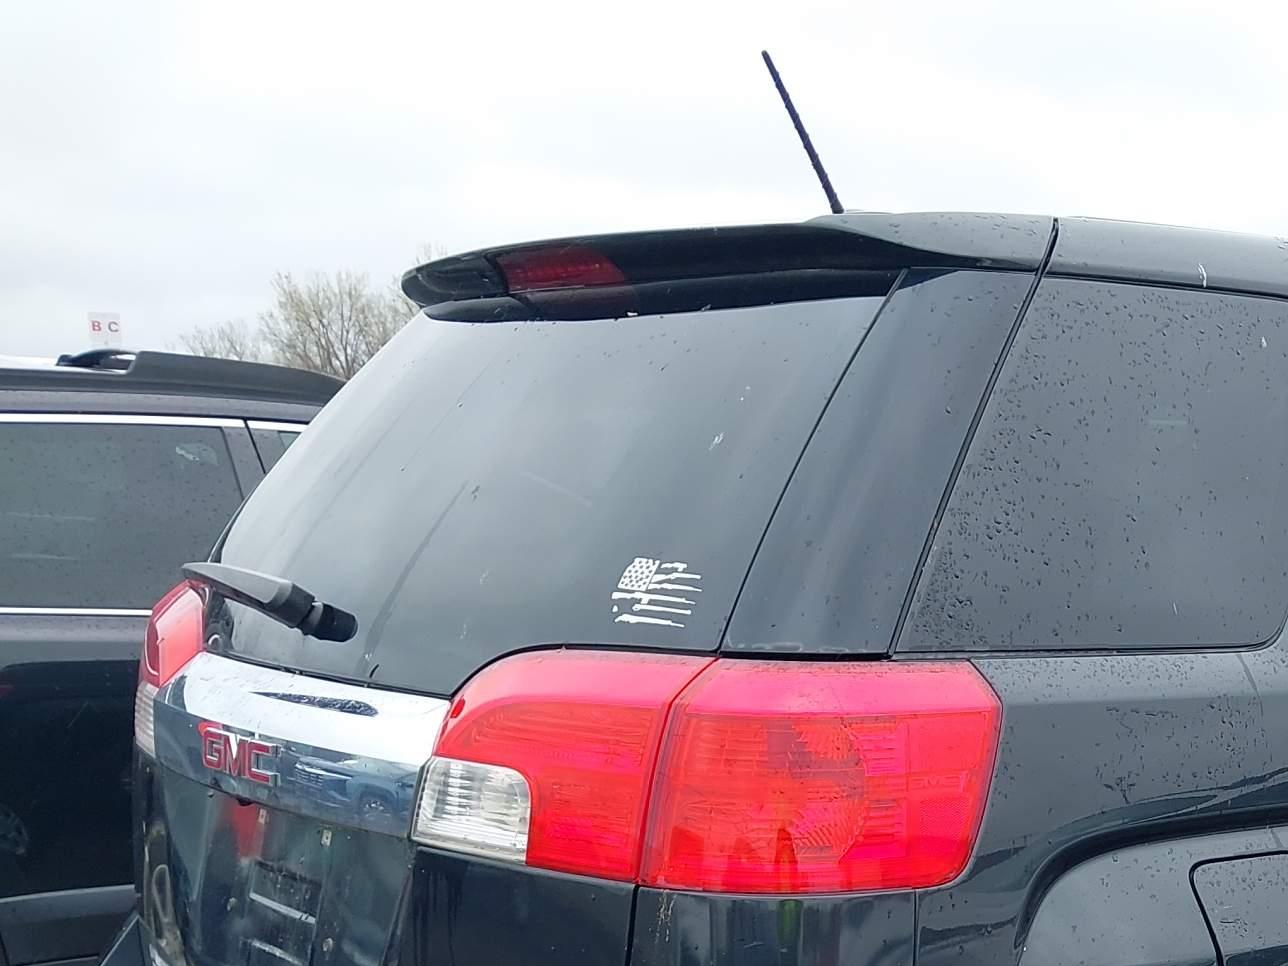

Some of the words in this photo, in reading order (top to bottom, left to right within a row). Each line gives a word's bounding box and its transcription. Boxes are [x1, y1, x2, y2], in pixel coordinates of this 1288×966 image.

[91, 320, 102, 331] B
[107, 320, 119, 332] C
[202, 727, 279, 787] GMC
